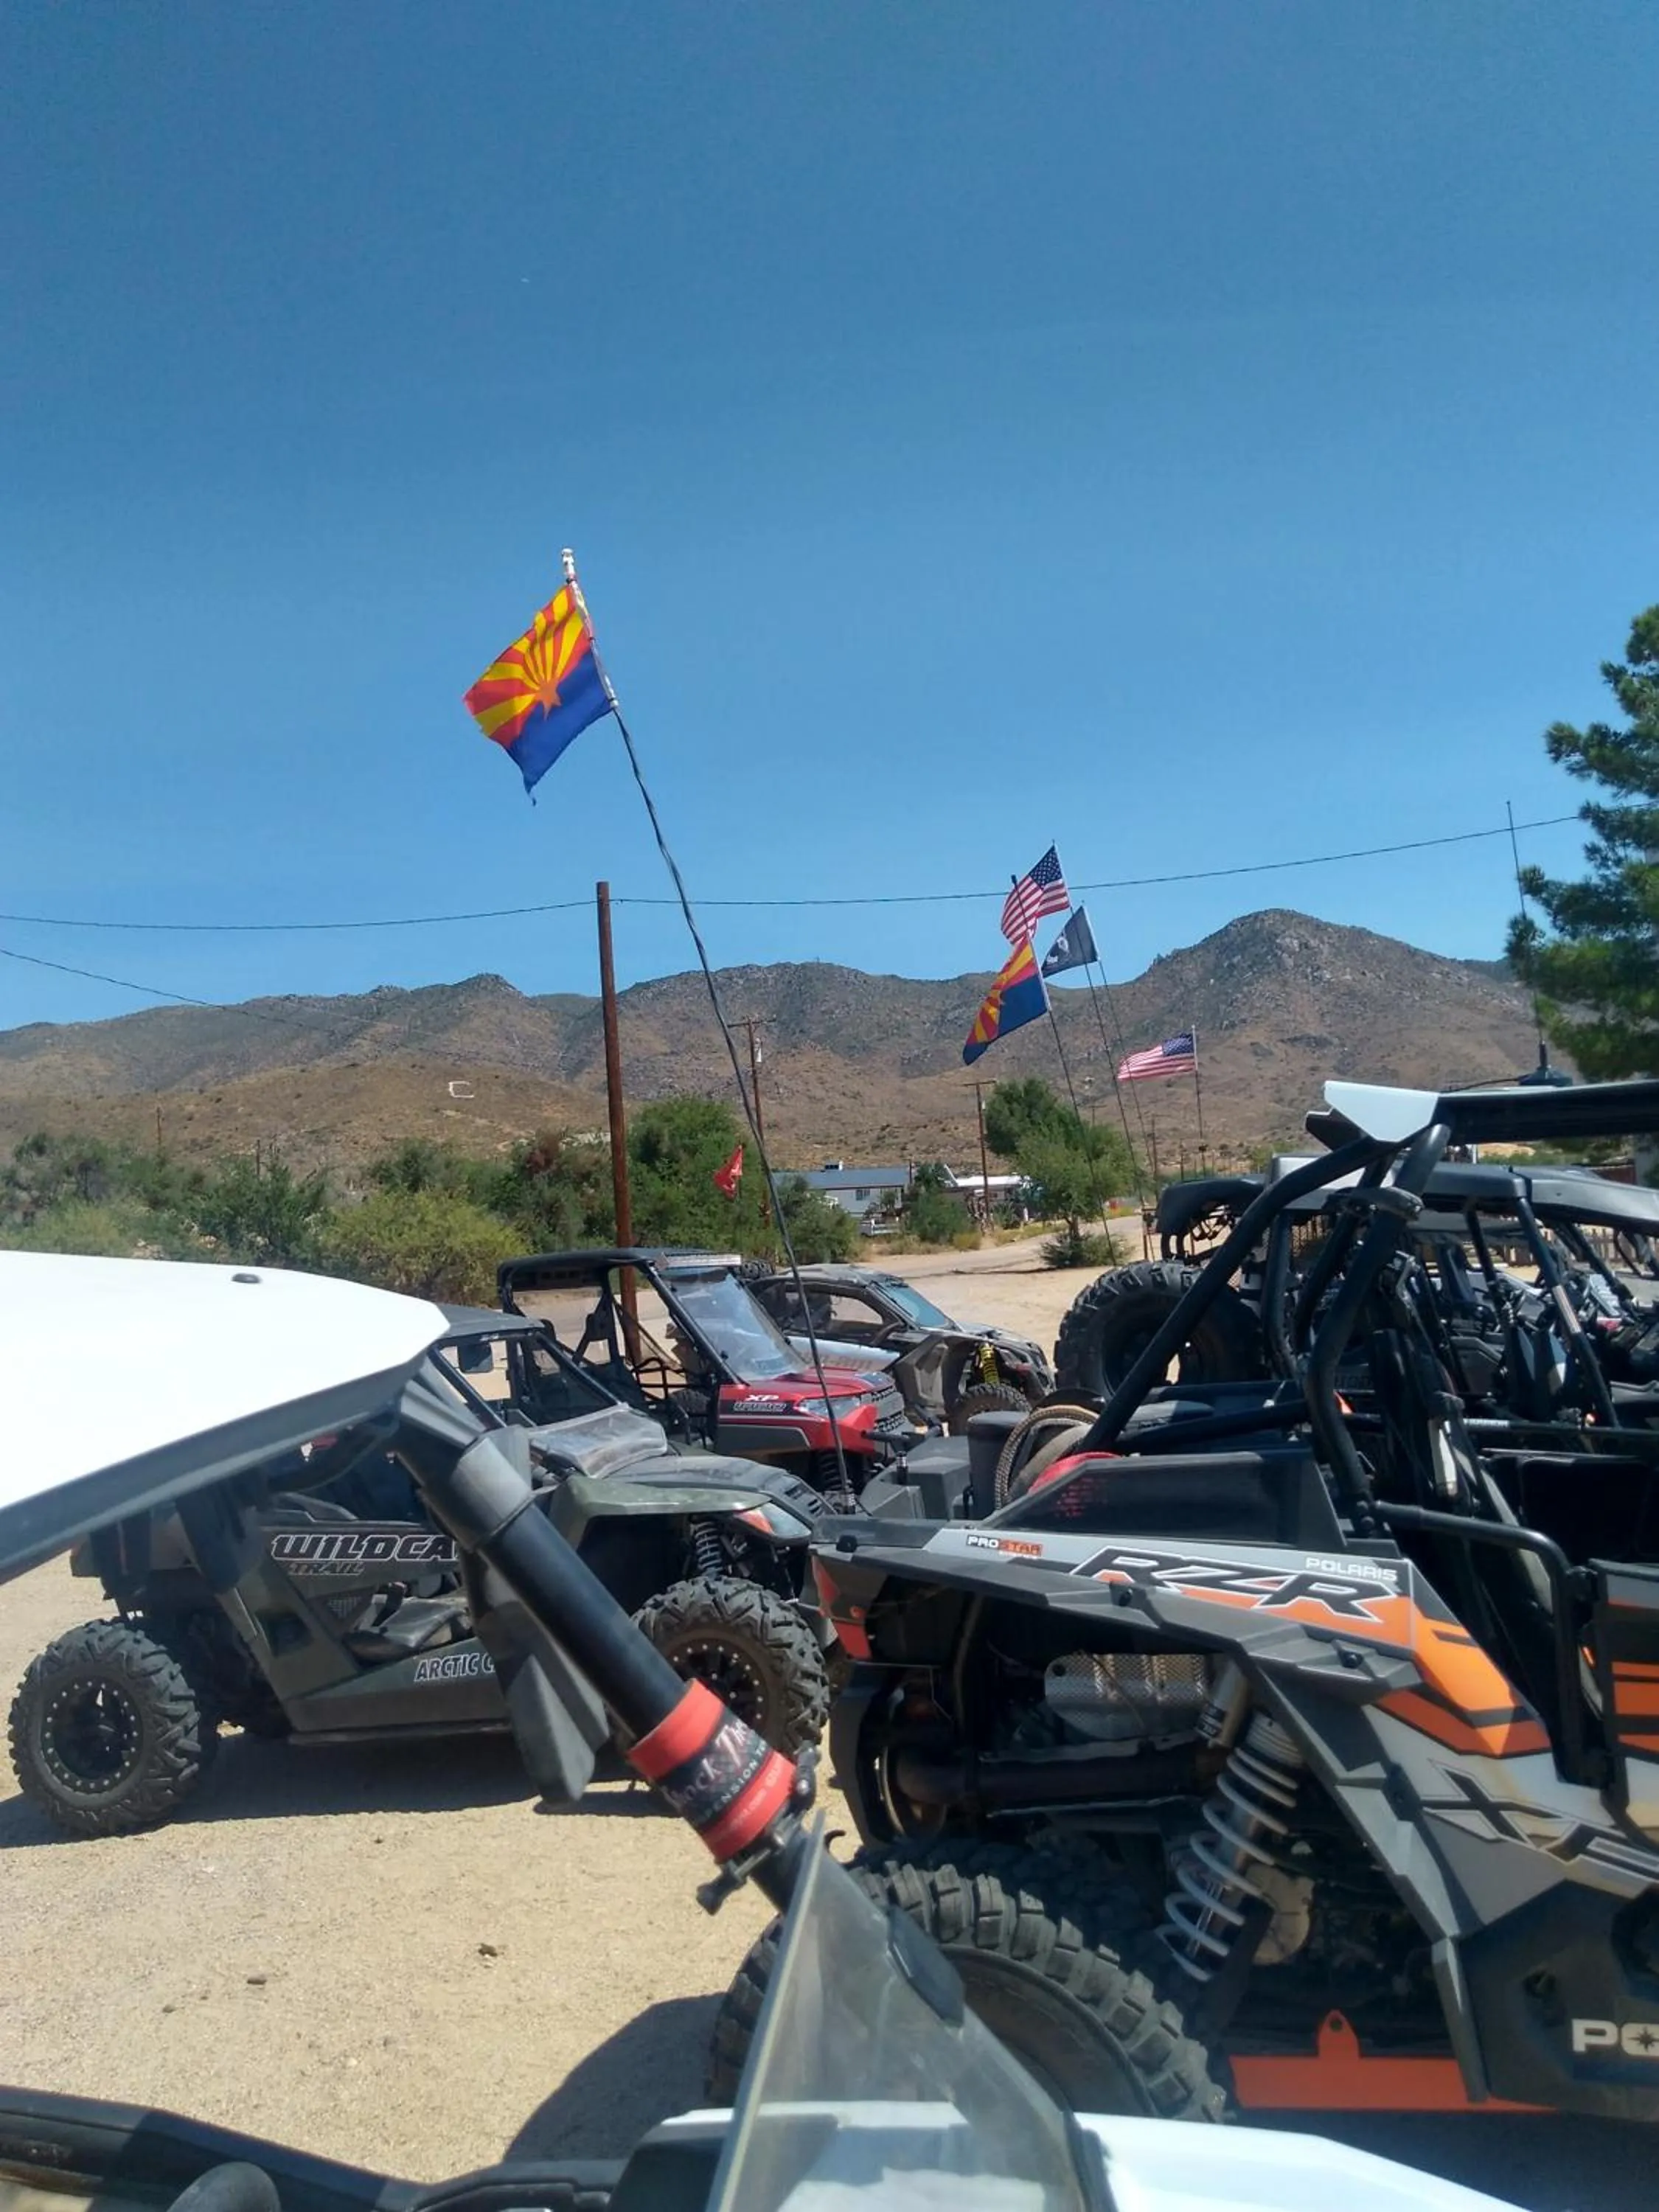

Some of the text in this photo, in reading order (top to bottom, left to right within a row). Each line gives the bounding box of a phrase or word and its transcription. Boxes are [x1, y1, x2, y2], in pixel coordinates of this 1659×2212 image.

[744, 1394, 779, 1402] XP
[271, 1534, 459, 1561] WILDCA
[1305, 1556, 1398, 1582] POLARIS
[1070, 1545, 1398, 1623] RZR
[414, 1652, 496, 1682] ARCTIC C
